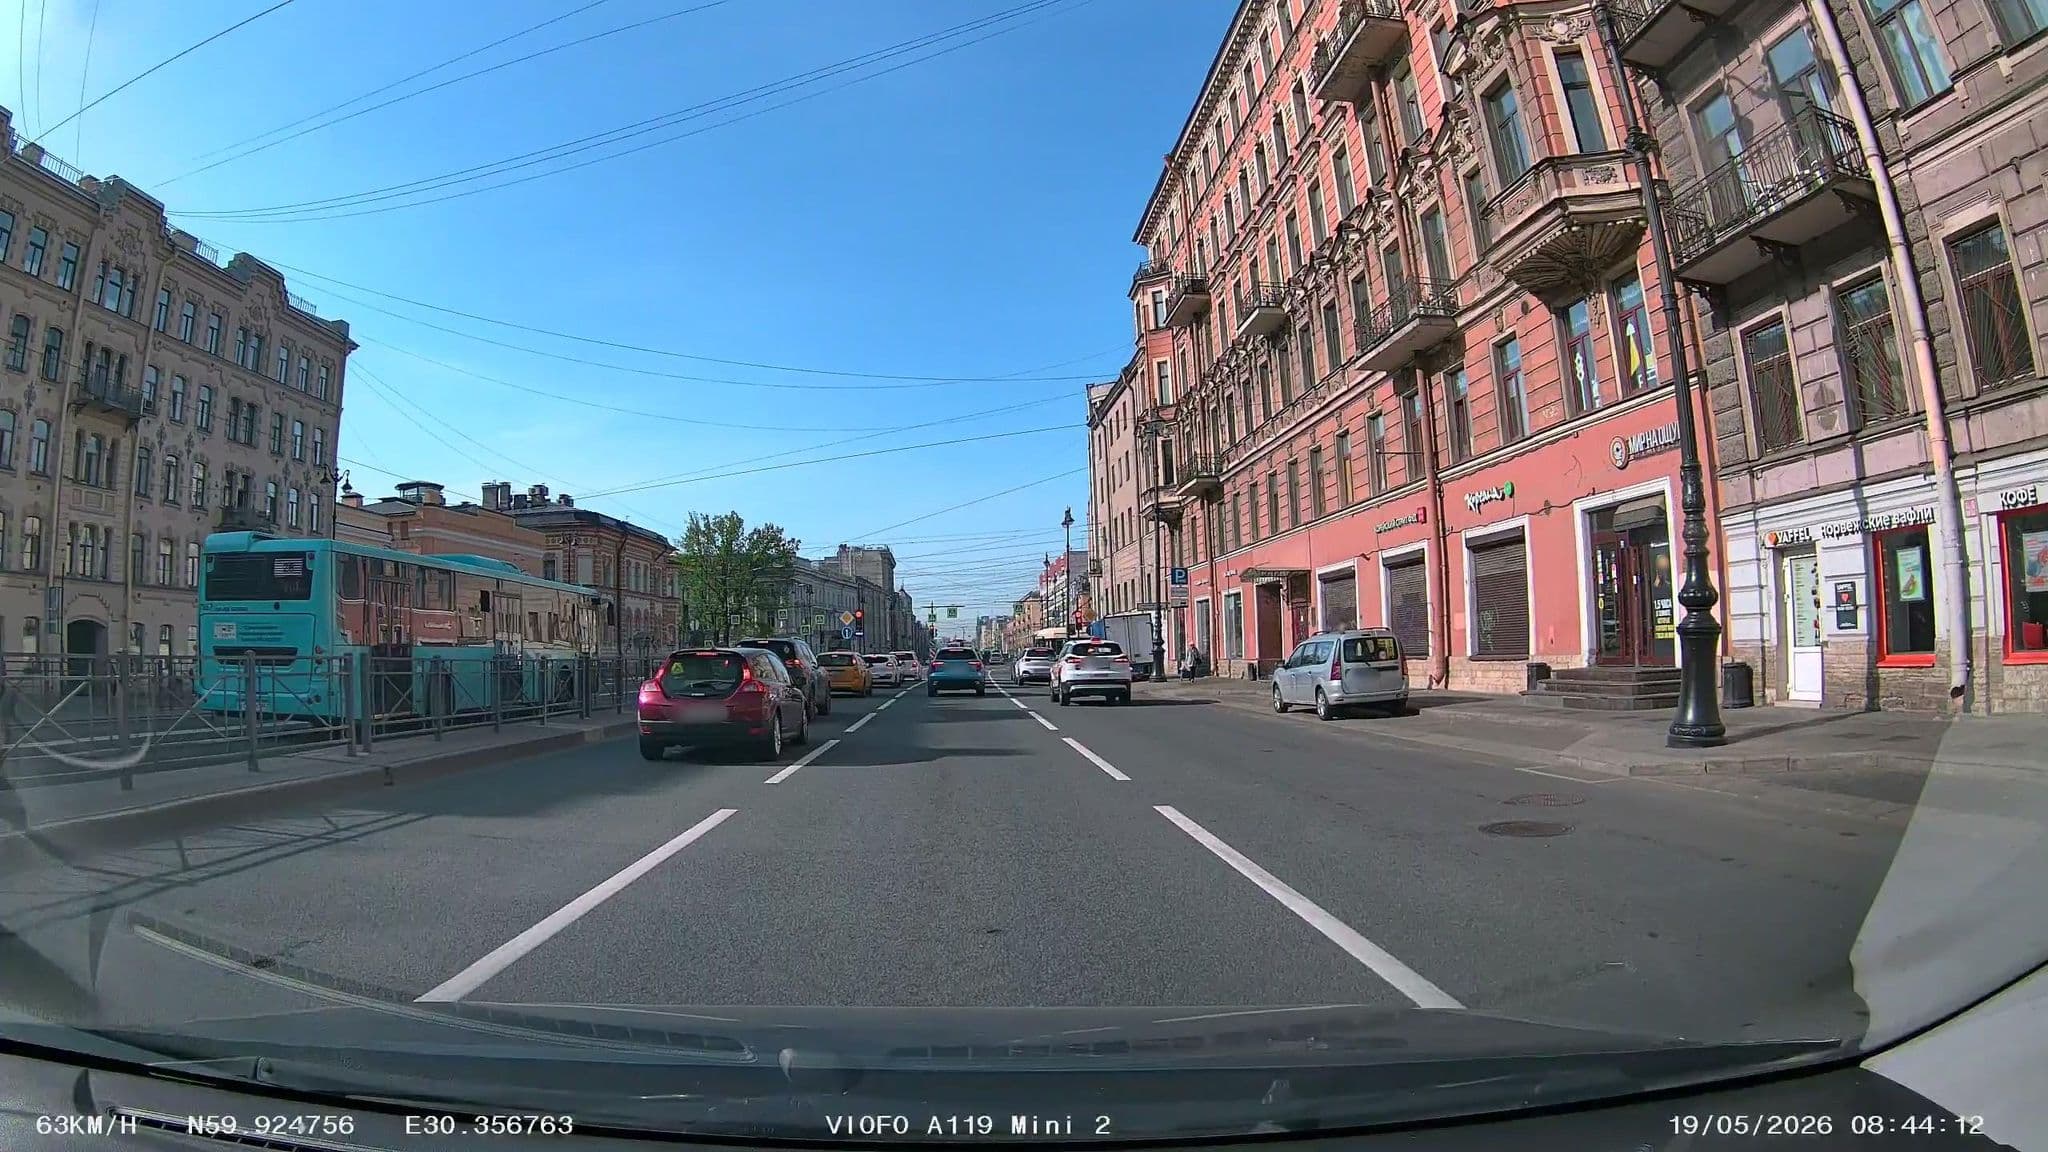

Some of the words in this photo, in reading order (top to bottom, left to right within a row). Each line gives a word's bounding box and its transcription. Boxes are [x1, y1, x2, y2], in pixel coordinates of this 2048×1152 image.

[1628, 433, 1646, 454] МИР
[1646, 429, 1658, 448] НА
[2000, 485, 2038, 509] КОФЕ
[1821, 515, 1892, 539] норвежские
[1892, 507, 1934, 524] вафли
